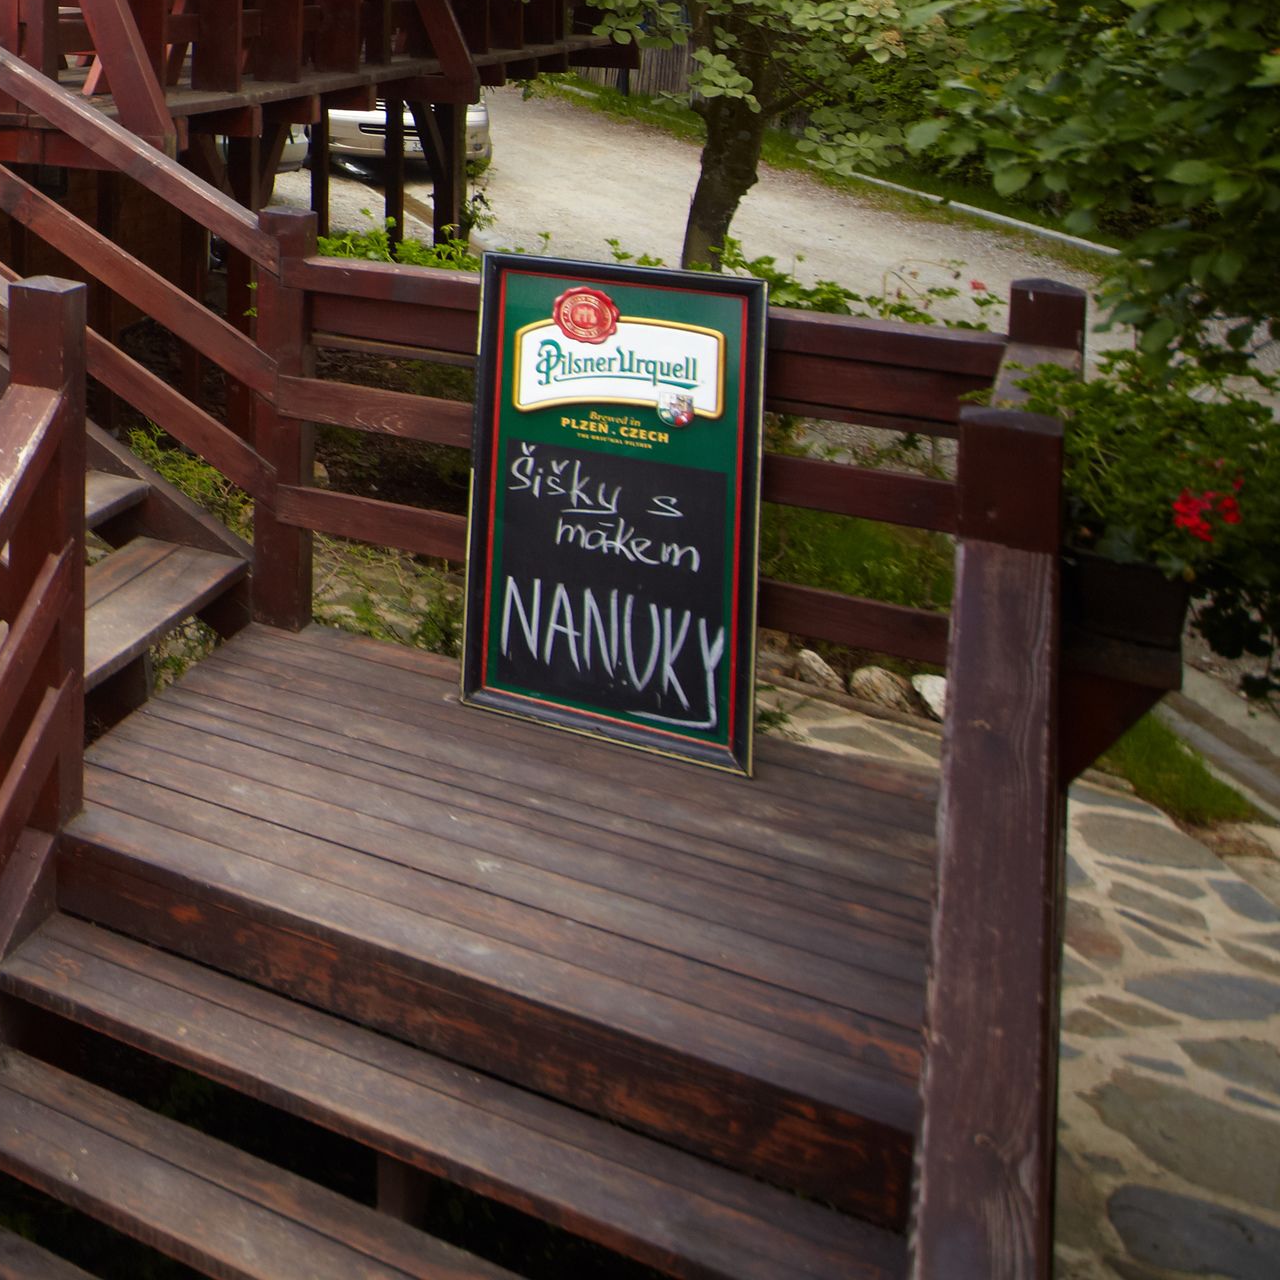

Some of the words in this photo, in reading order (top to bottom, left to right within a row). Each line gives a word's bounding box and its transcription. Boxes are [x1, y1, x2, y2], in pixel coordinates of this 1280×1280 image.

[536, 338, 618, 386] Pilsner
[615, 345, 698, 386] Urquell
[590, 411, 629, 425] Brewed
[630, 417, 641, 427] in
[620, 426, 670, 444] CZECH
[509, 442, 622, 514] Šišky
[501, 575, 725, 730] NANUKY
